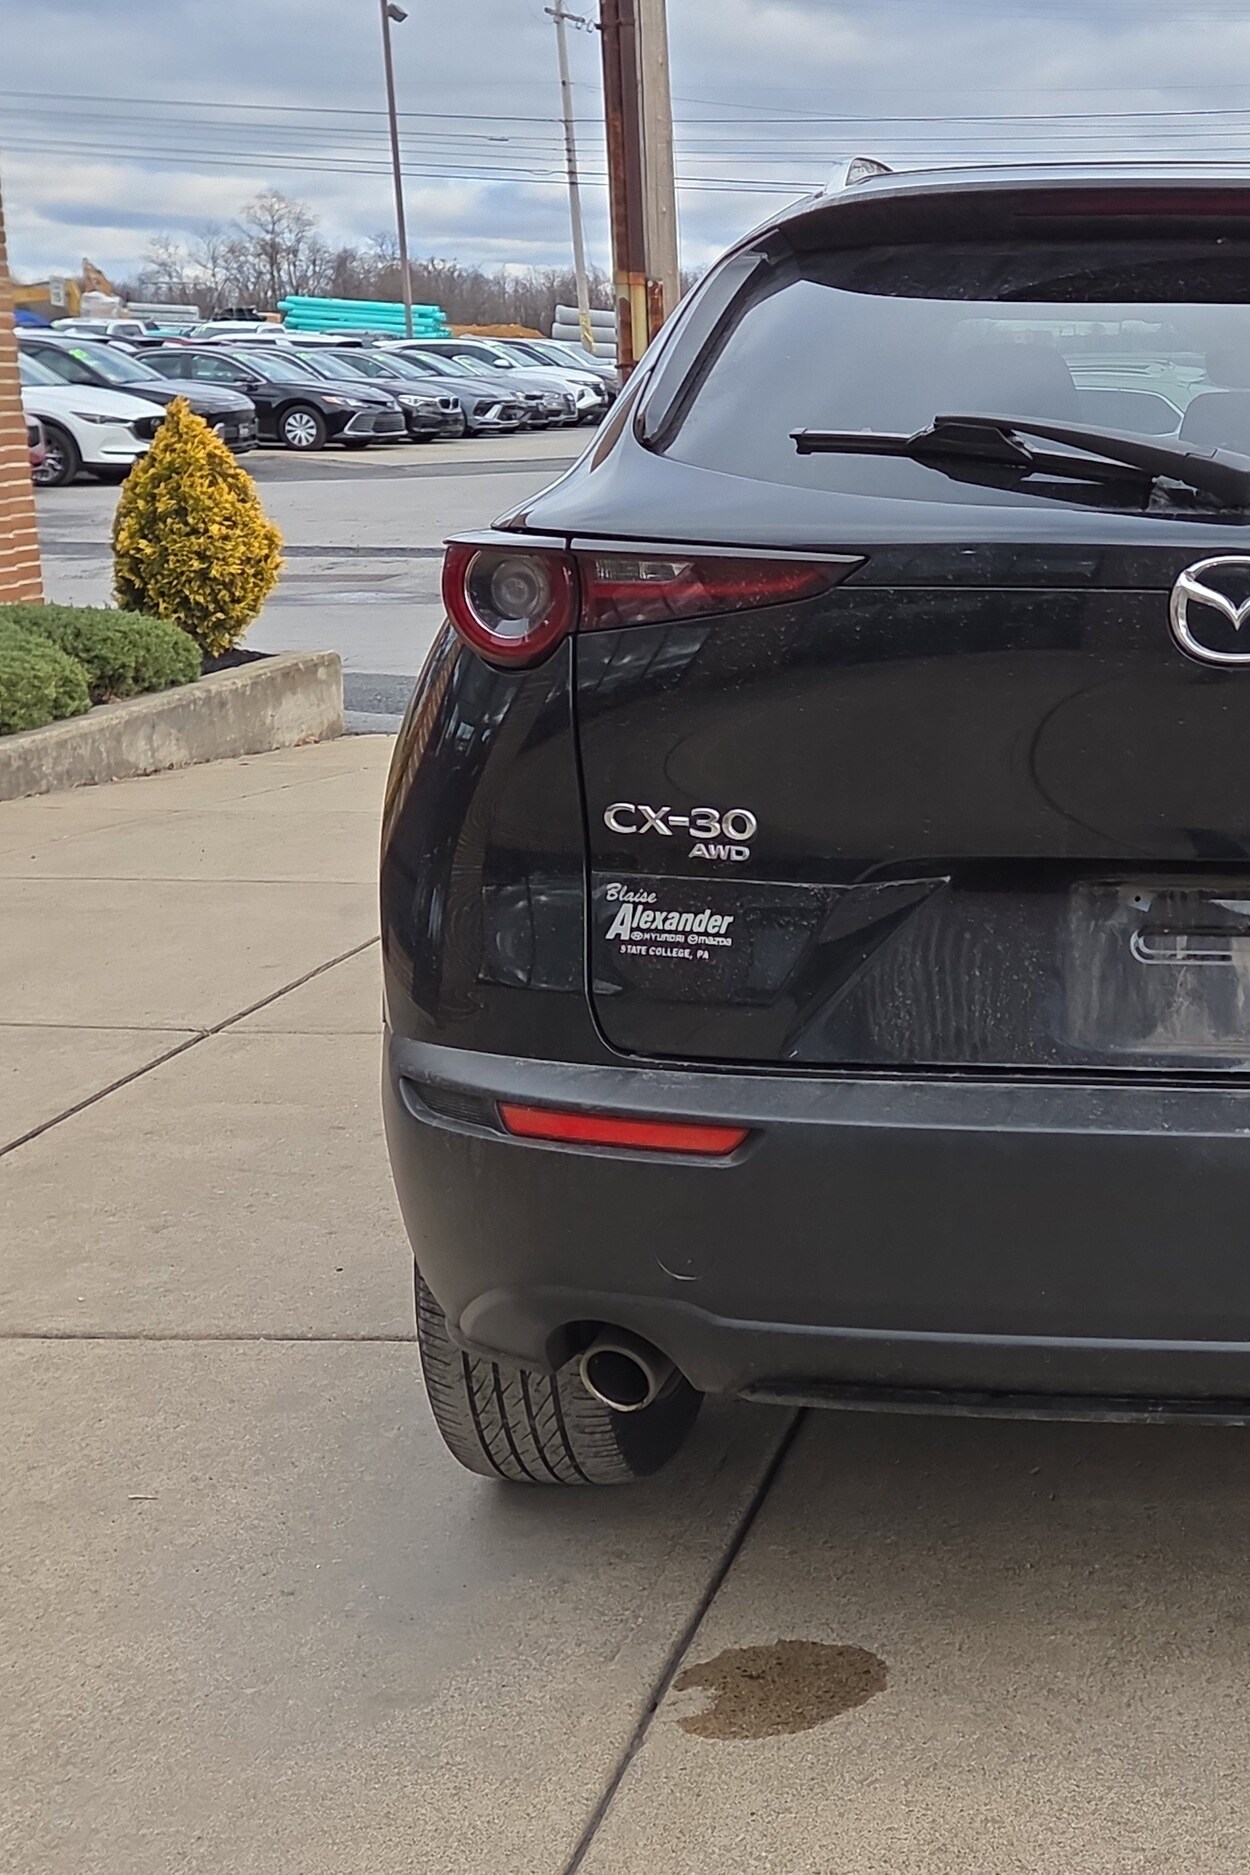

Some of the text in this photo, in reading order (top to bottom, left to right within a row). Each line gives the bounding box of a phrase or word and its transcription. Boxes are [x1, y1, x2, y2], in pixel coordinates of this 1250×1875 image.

[603, 802, 757, 841] CX-30
[688, 843, 750, 861] AWD
[606, 882, 658, 903] Blaise
[605, 903, 734, 940] Alexander
[644, 933, 684, 943] HYUNDAI
[620, 945, 709, 959] STATE COLLEGE, PA
